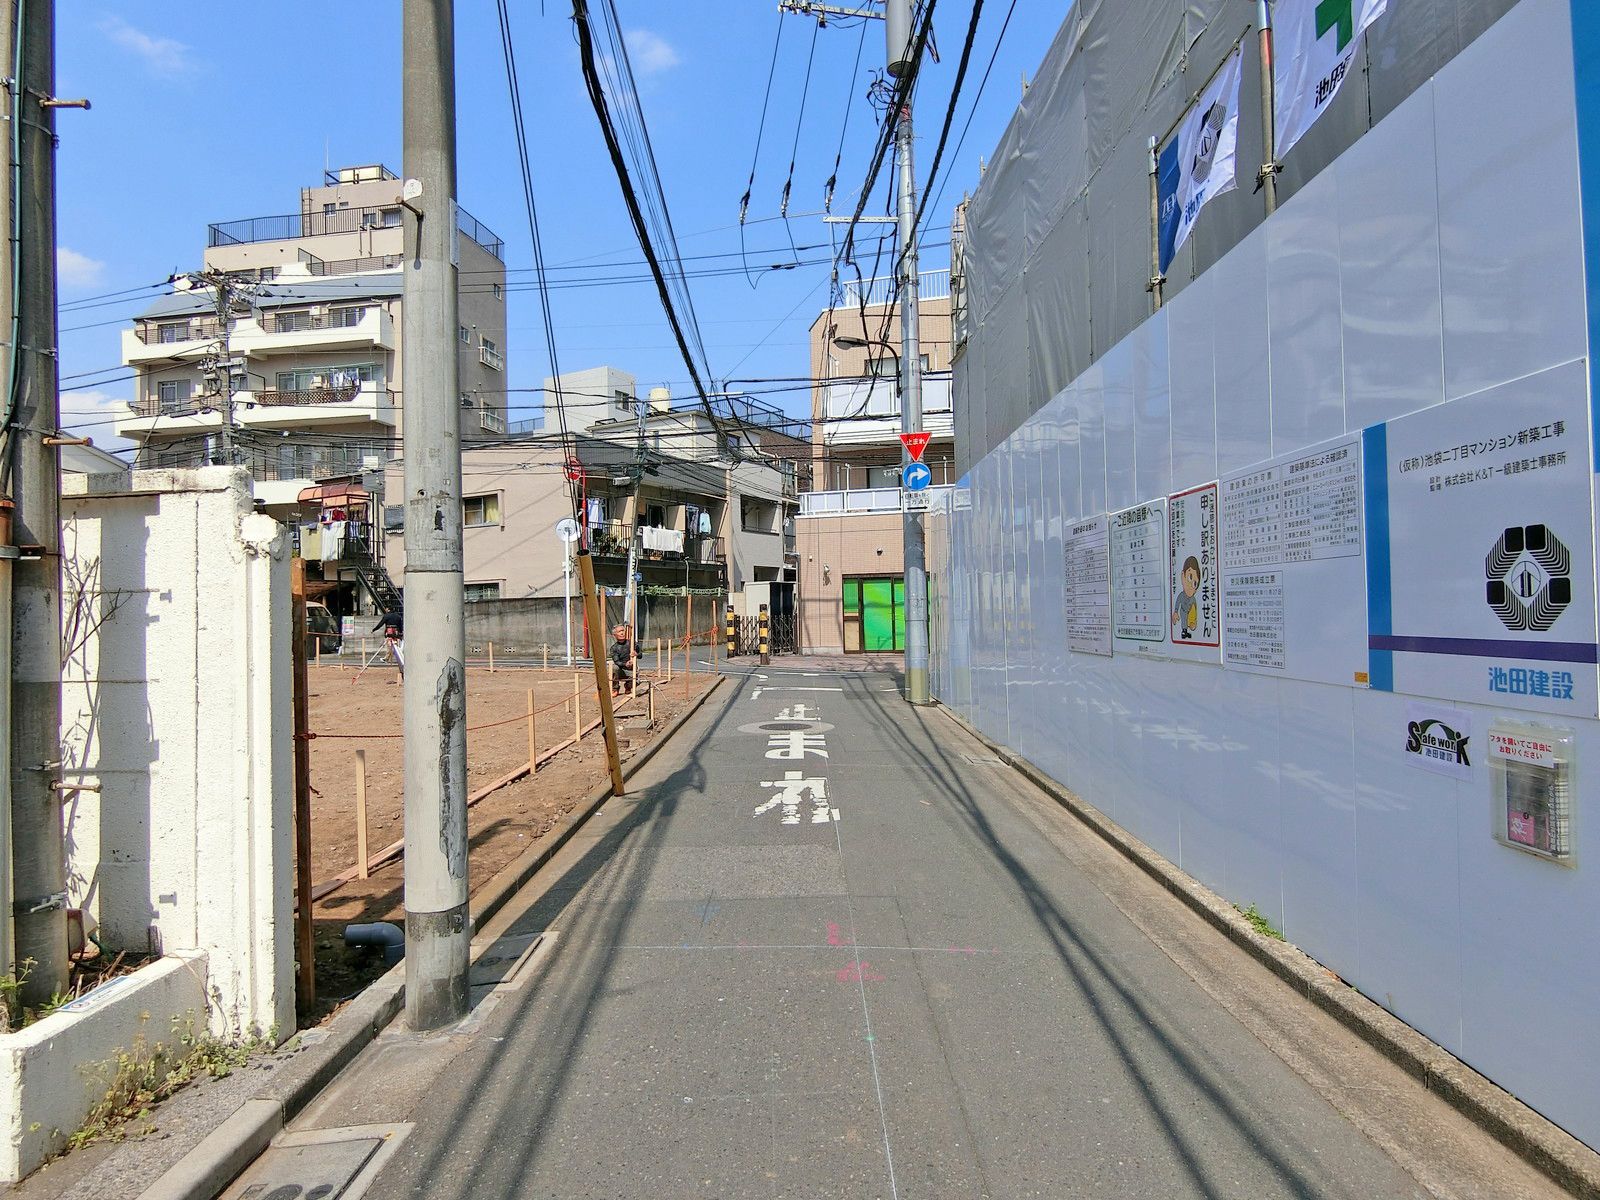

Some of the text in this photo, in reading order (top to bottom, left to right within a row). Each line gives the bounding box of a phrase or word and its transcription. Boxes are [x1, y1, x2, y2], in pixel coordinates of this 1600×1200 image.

[1289, 449, 1348, 474] 建築基準法による確認済
[1398, 420, 1565, 474] (仮称)池袋二丁目マンション新築工事
[1444, 452, 1566, 488] 株式会社K&T一級建築士事務所
[1117, 506, 1153, 527] ご近隣の皆様へ
[1200, 494, 1212, 638] 申し訳ありません
[1488, 666, 1574, 700] 池田建設
[1408, 720, 1436, 752] Safe
[1489, 734, 1552, 752] フタを開いてご自由に
[753, 704, 841, 824] 止まれ
[1425, 748, 1453, 762] 池田建設
[1499, 746, 1543, 759] お取りください
